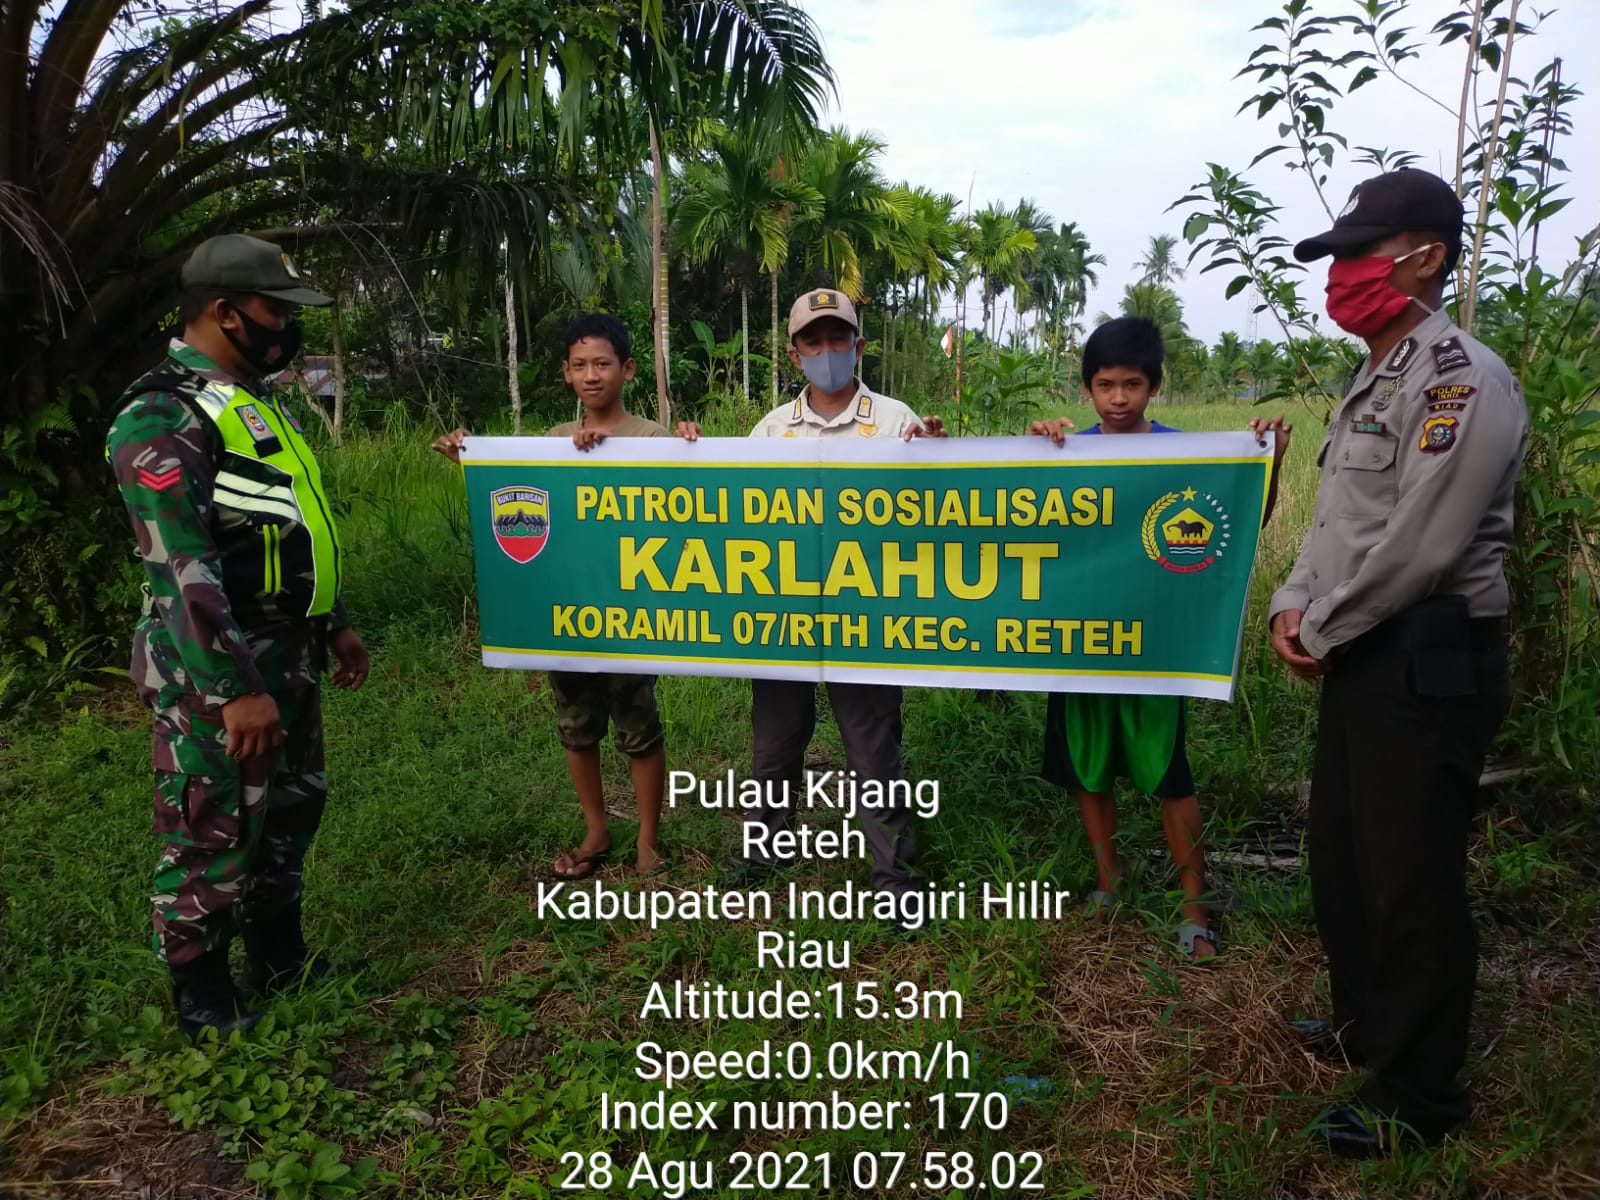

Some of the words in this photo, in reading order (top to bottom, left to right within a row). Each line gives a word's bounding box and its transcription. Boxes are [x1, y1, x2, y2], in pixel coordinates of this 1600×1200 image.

[1430, 386, 1471, 397] POLRES
[576, 485, 729, 524] PATROLI
[743, 487, 824, 526] DAN
[837, 487, 1114, 527] SOSIALISASI
[619, 536, 1060, 601] KARLAHUT
[552, 604, 722, 644] KORAMIL
[732, 611, 869, 649] 07/RTH
[883, 615, 981, 652] KEC.
[996, 618, 1143, 656] RETEH
